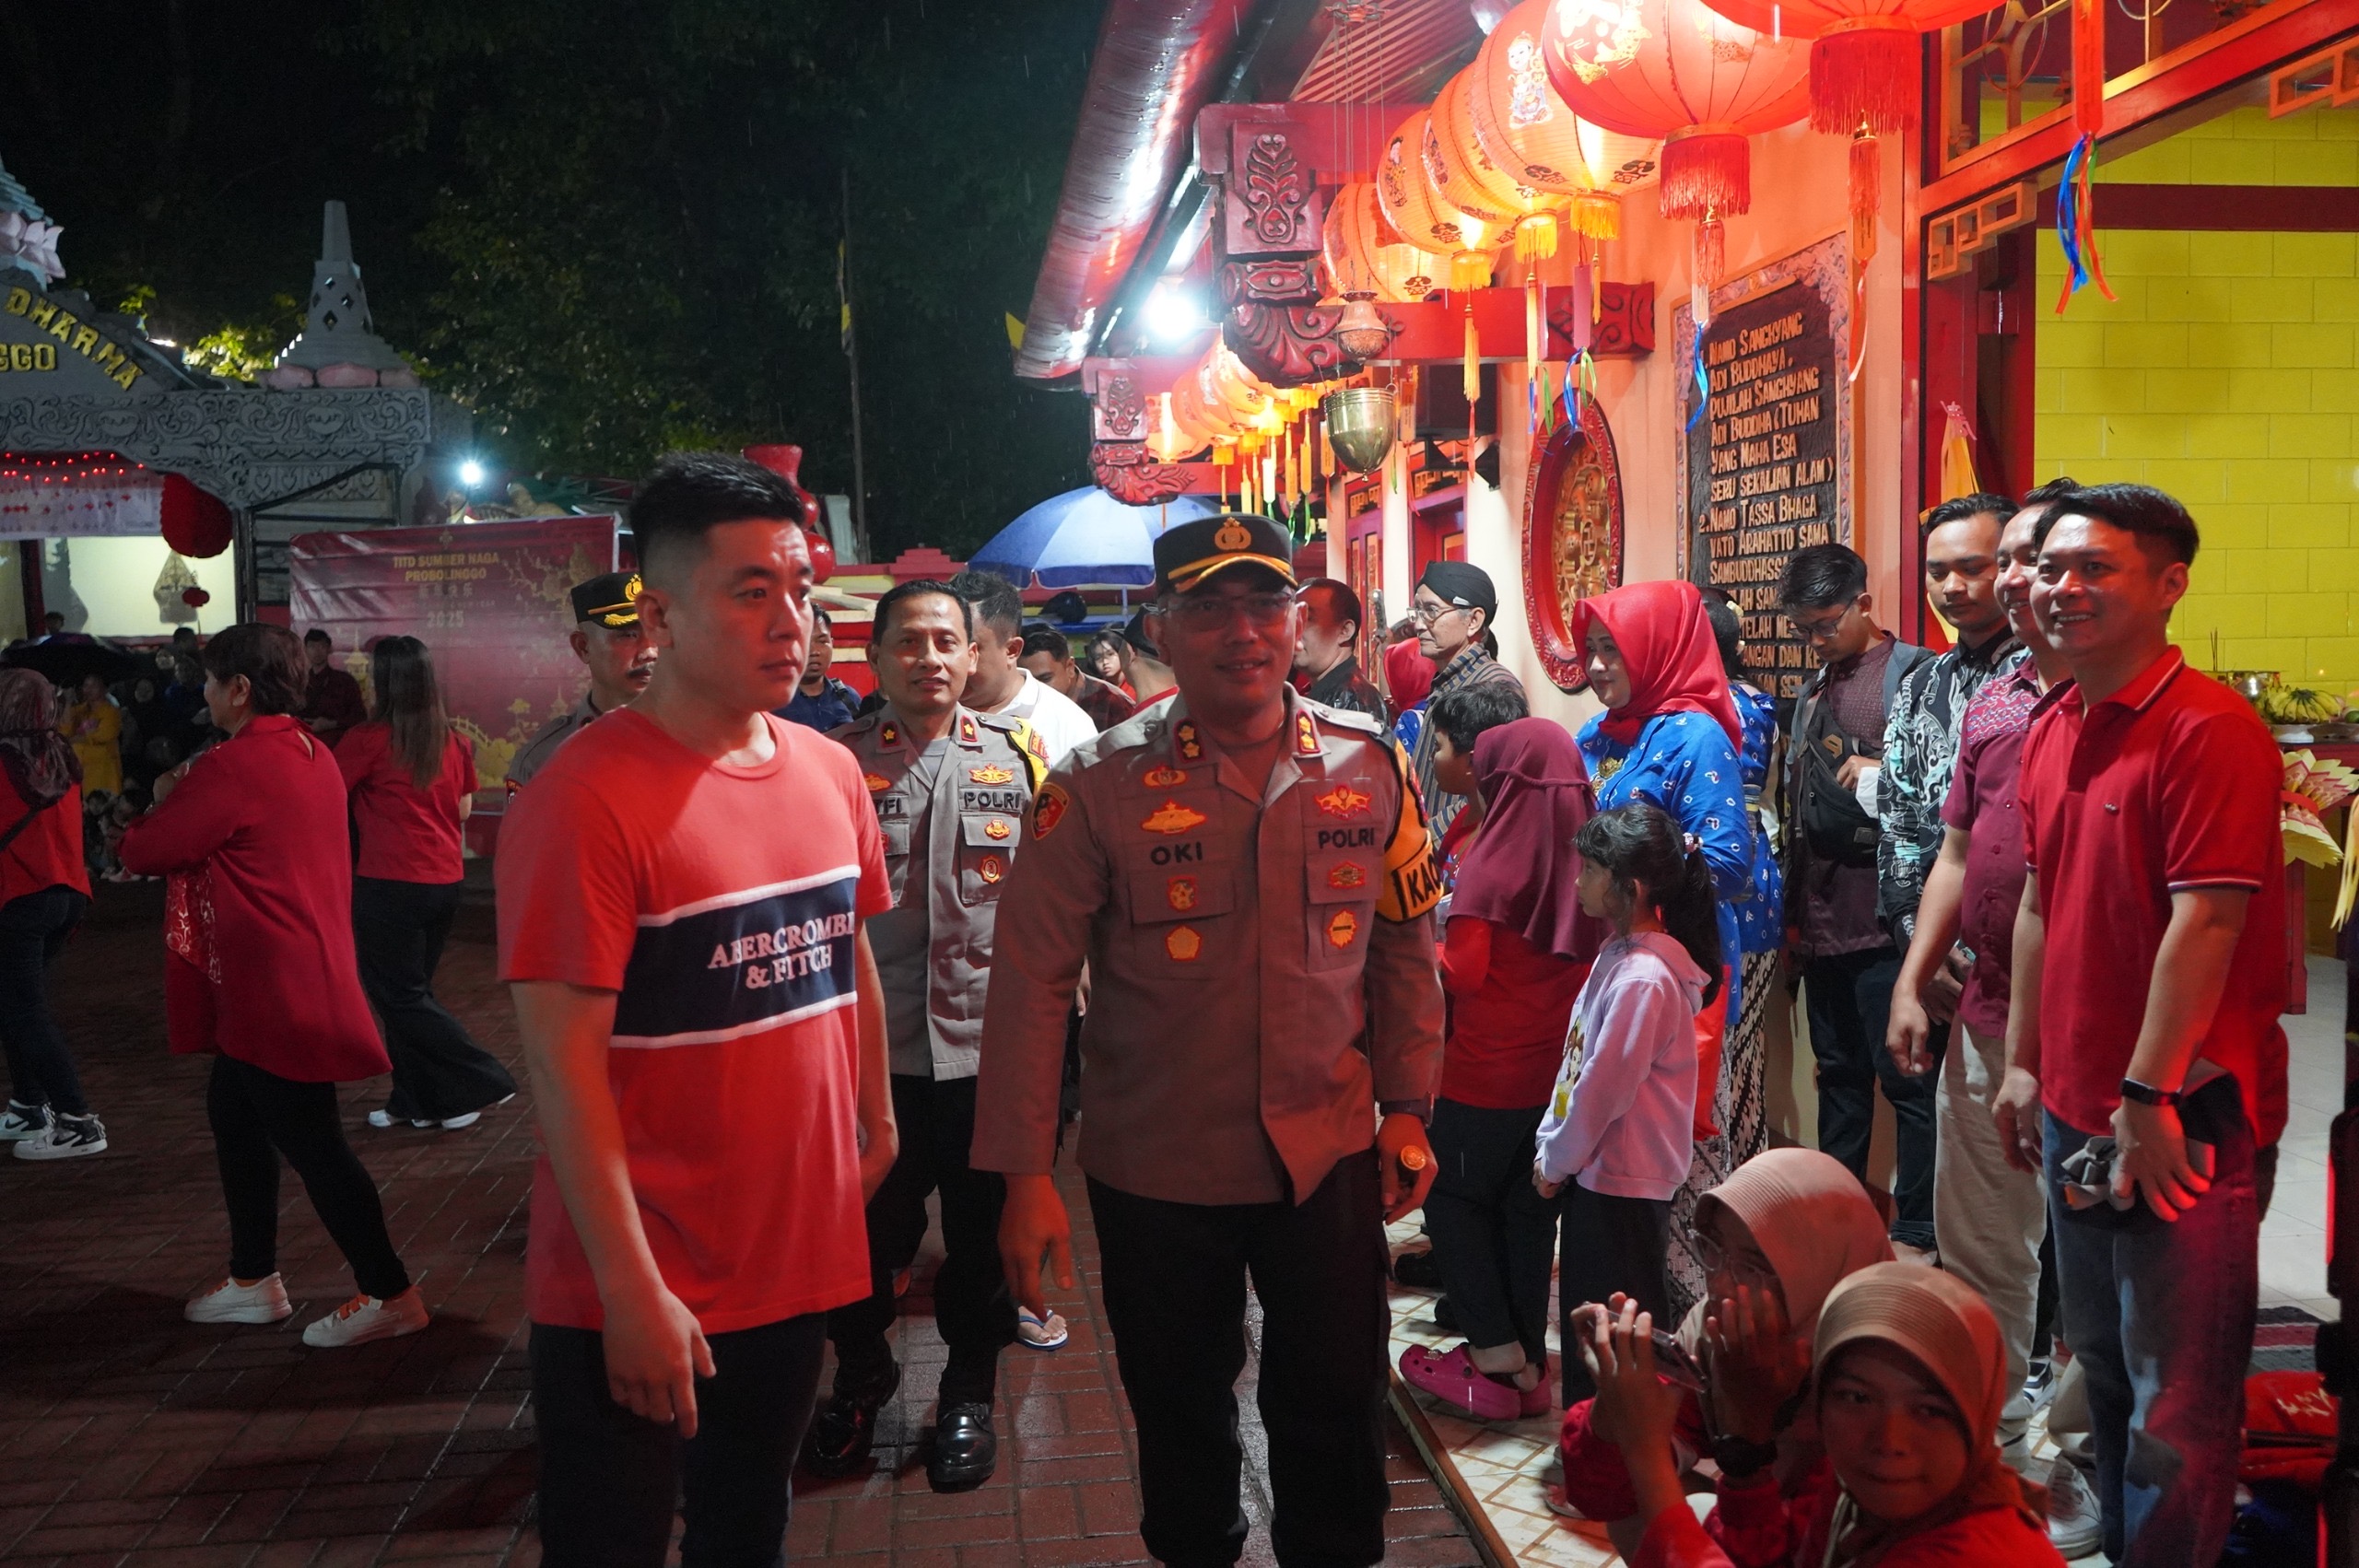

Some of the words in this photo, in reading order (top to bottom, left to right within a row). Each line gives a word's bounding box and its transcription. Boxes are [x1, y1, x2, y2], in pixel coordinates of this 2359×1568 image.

[5, 287, 144, 391] DHARMA
[1710, 369, 1728, 394] ADI
[1710, 388, 1753, 421] PUJILAH
[1755, 367, 1820, 407] SANGHYANG
[1711, 422, 1728, 447] ADI
[1731, 411, 1772, 442] BUDDHA
[1711, 449, 1738, 474] YANG
[1741, 440, 1770, 468] MAHA
[1773, 432, 1797, 461] ESA
[1711, 477, 1736, 502] SERU
[1740, 465, 1790, 497] SEKALIAN
[1740, 499, 1776, 528] TASSA
[1778, 494, 1817, 522] BHAGA
[1710, 535, 1735, 558] VATO
[1739, 527, 1795, 556] ARAHATTO
[1800, 522, 1829, 548] SAMA
[468, 552, 499, 564] NAGA
[1779, 645, 1802, 668] DAN
[964, 791, 1021, 809] POLRI
[1151, 842, 1203, 866] OKI
[1319, 827, 1375, 848] POLRI
[745, 965, 771, 989] &
[773, 944, 832, 983] FITCH
